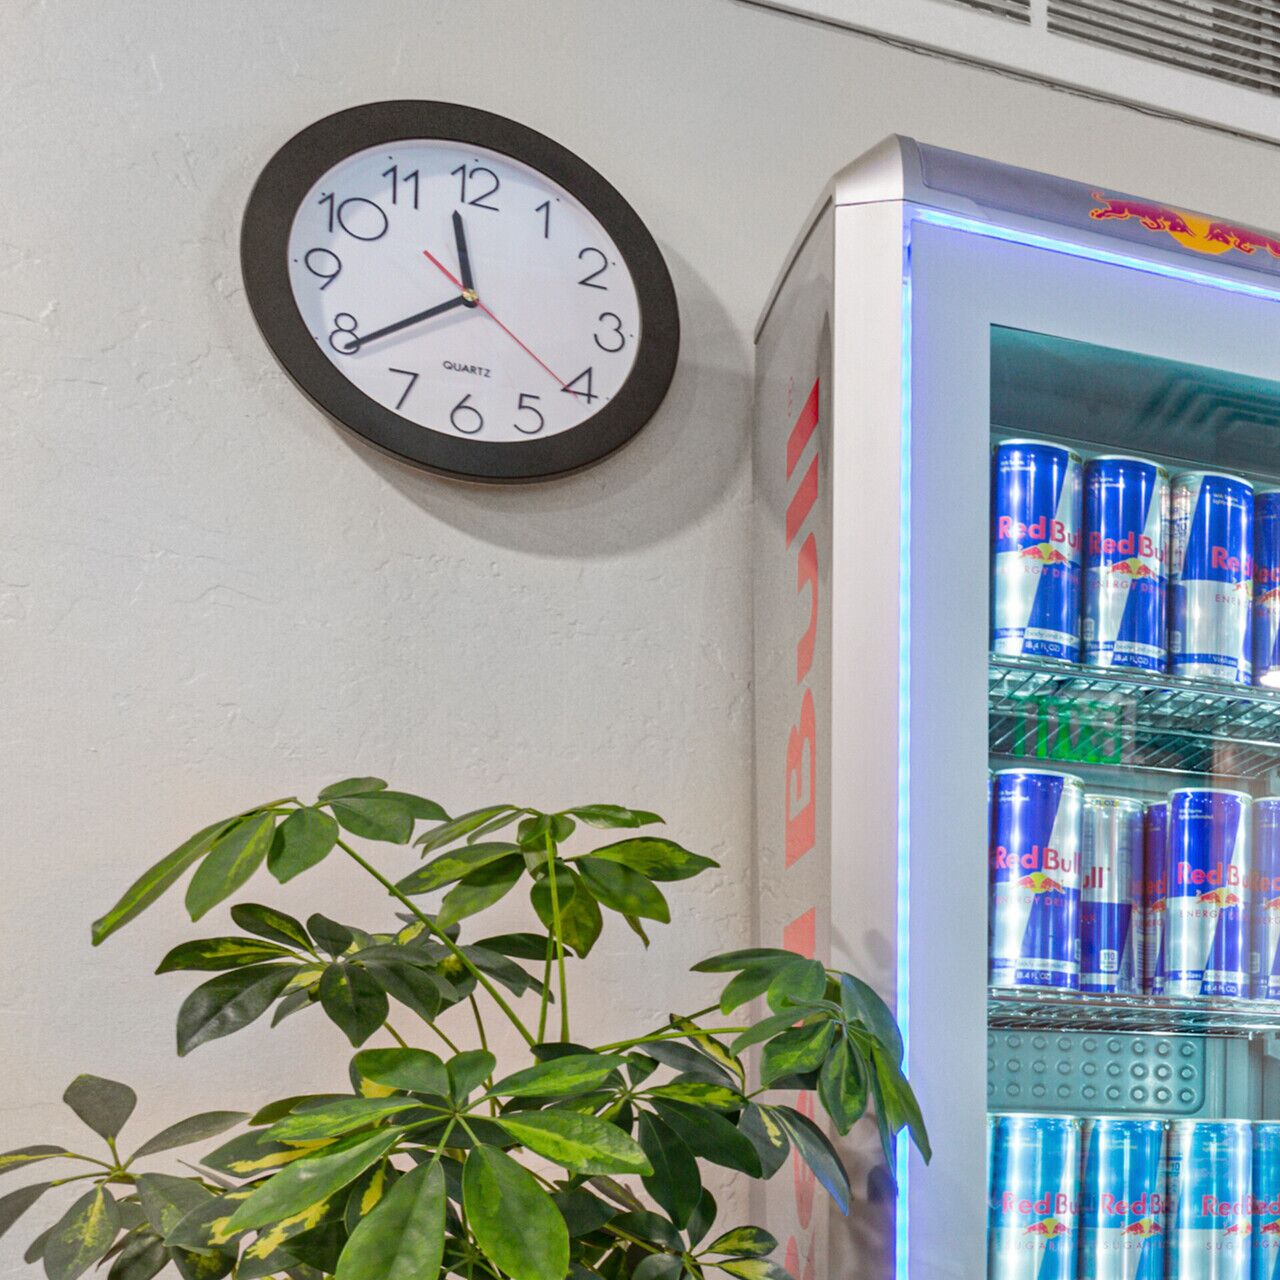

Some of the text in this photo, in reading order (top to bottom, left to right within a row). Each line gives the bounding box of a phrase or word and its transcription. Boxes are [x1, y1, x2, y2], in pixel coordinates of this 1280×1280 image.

[381, 165, 420, 209] 11
[450, 164, 500, 211] 12
[318, 192, 389, 241] 10
[534, 200, 550, 239] 1
[304, 247, 342, 290] 9
[577, 247, 608, 290] 2
[328, 312, 361, 355] 8
[593, 311, 625, 352] 3
[388, 367, 420, 410] 7
[442, 359, 492, 378] QUARTZ
[560, 366, 599, 405] 4
[449, 393, 484, 434] 6
[513, 393, 545, 434] 5
[998, 516, 1046, 541] Red
[1089, 531, 1134, 556] Red
[785, 376, 819, 870] Bull
[995, 845, 1038, 870] Red
[1177, 861, 1222, 886] Red
[1002, 1191, 1050, 1215] Red
[1101, 1192, 1147, 1215] Red
